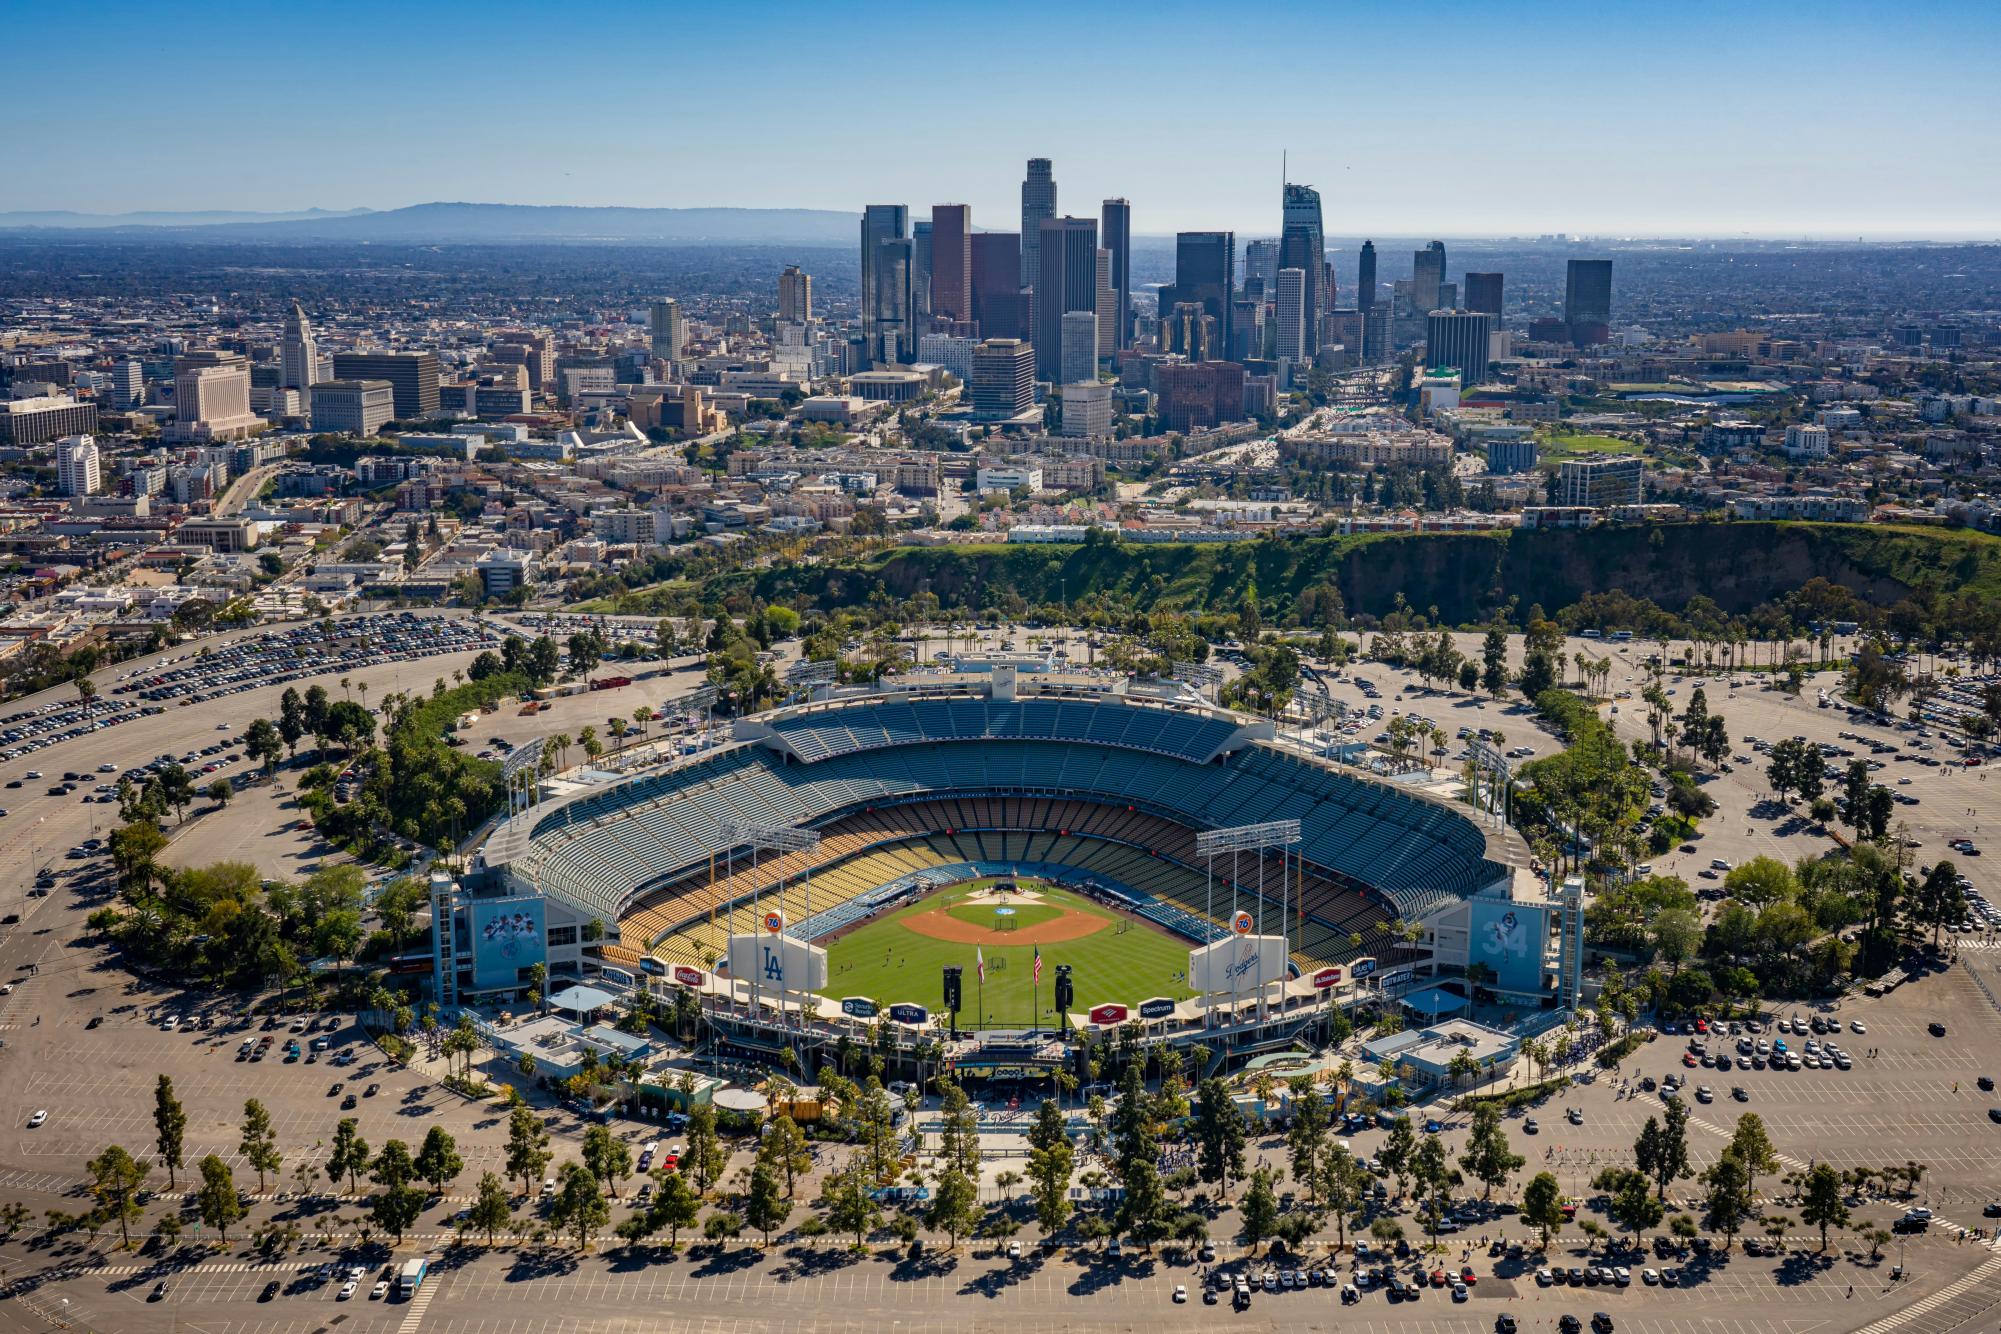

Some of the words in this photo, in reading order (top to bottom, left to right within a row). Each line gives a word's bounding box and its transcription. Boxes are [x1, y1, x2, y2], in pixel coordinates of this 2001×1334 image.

[768, 918, 779, 928] 76
[1238, 918, 1249, 928] 76
[1482, 921, 1528, 957] 34
[764, 946, 782, 981] LA
[1225, 952, 1258, 979] Dodgers
[897, 1008, 919, 1017] ULTRA
[1142, 1005, 1171, 1015] Spectrum
